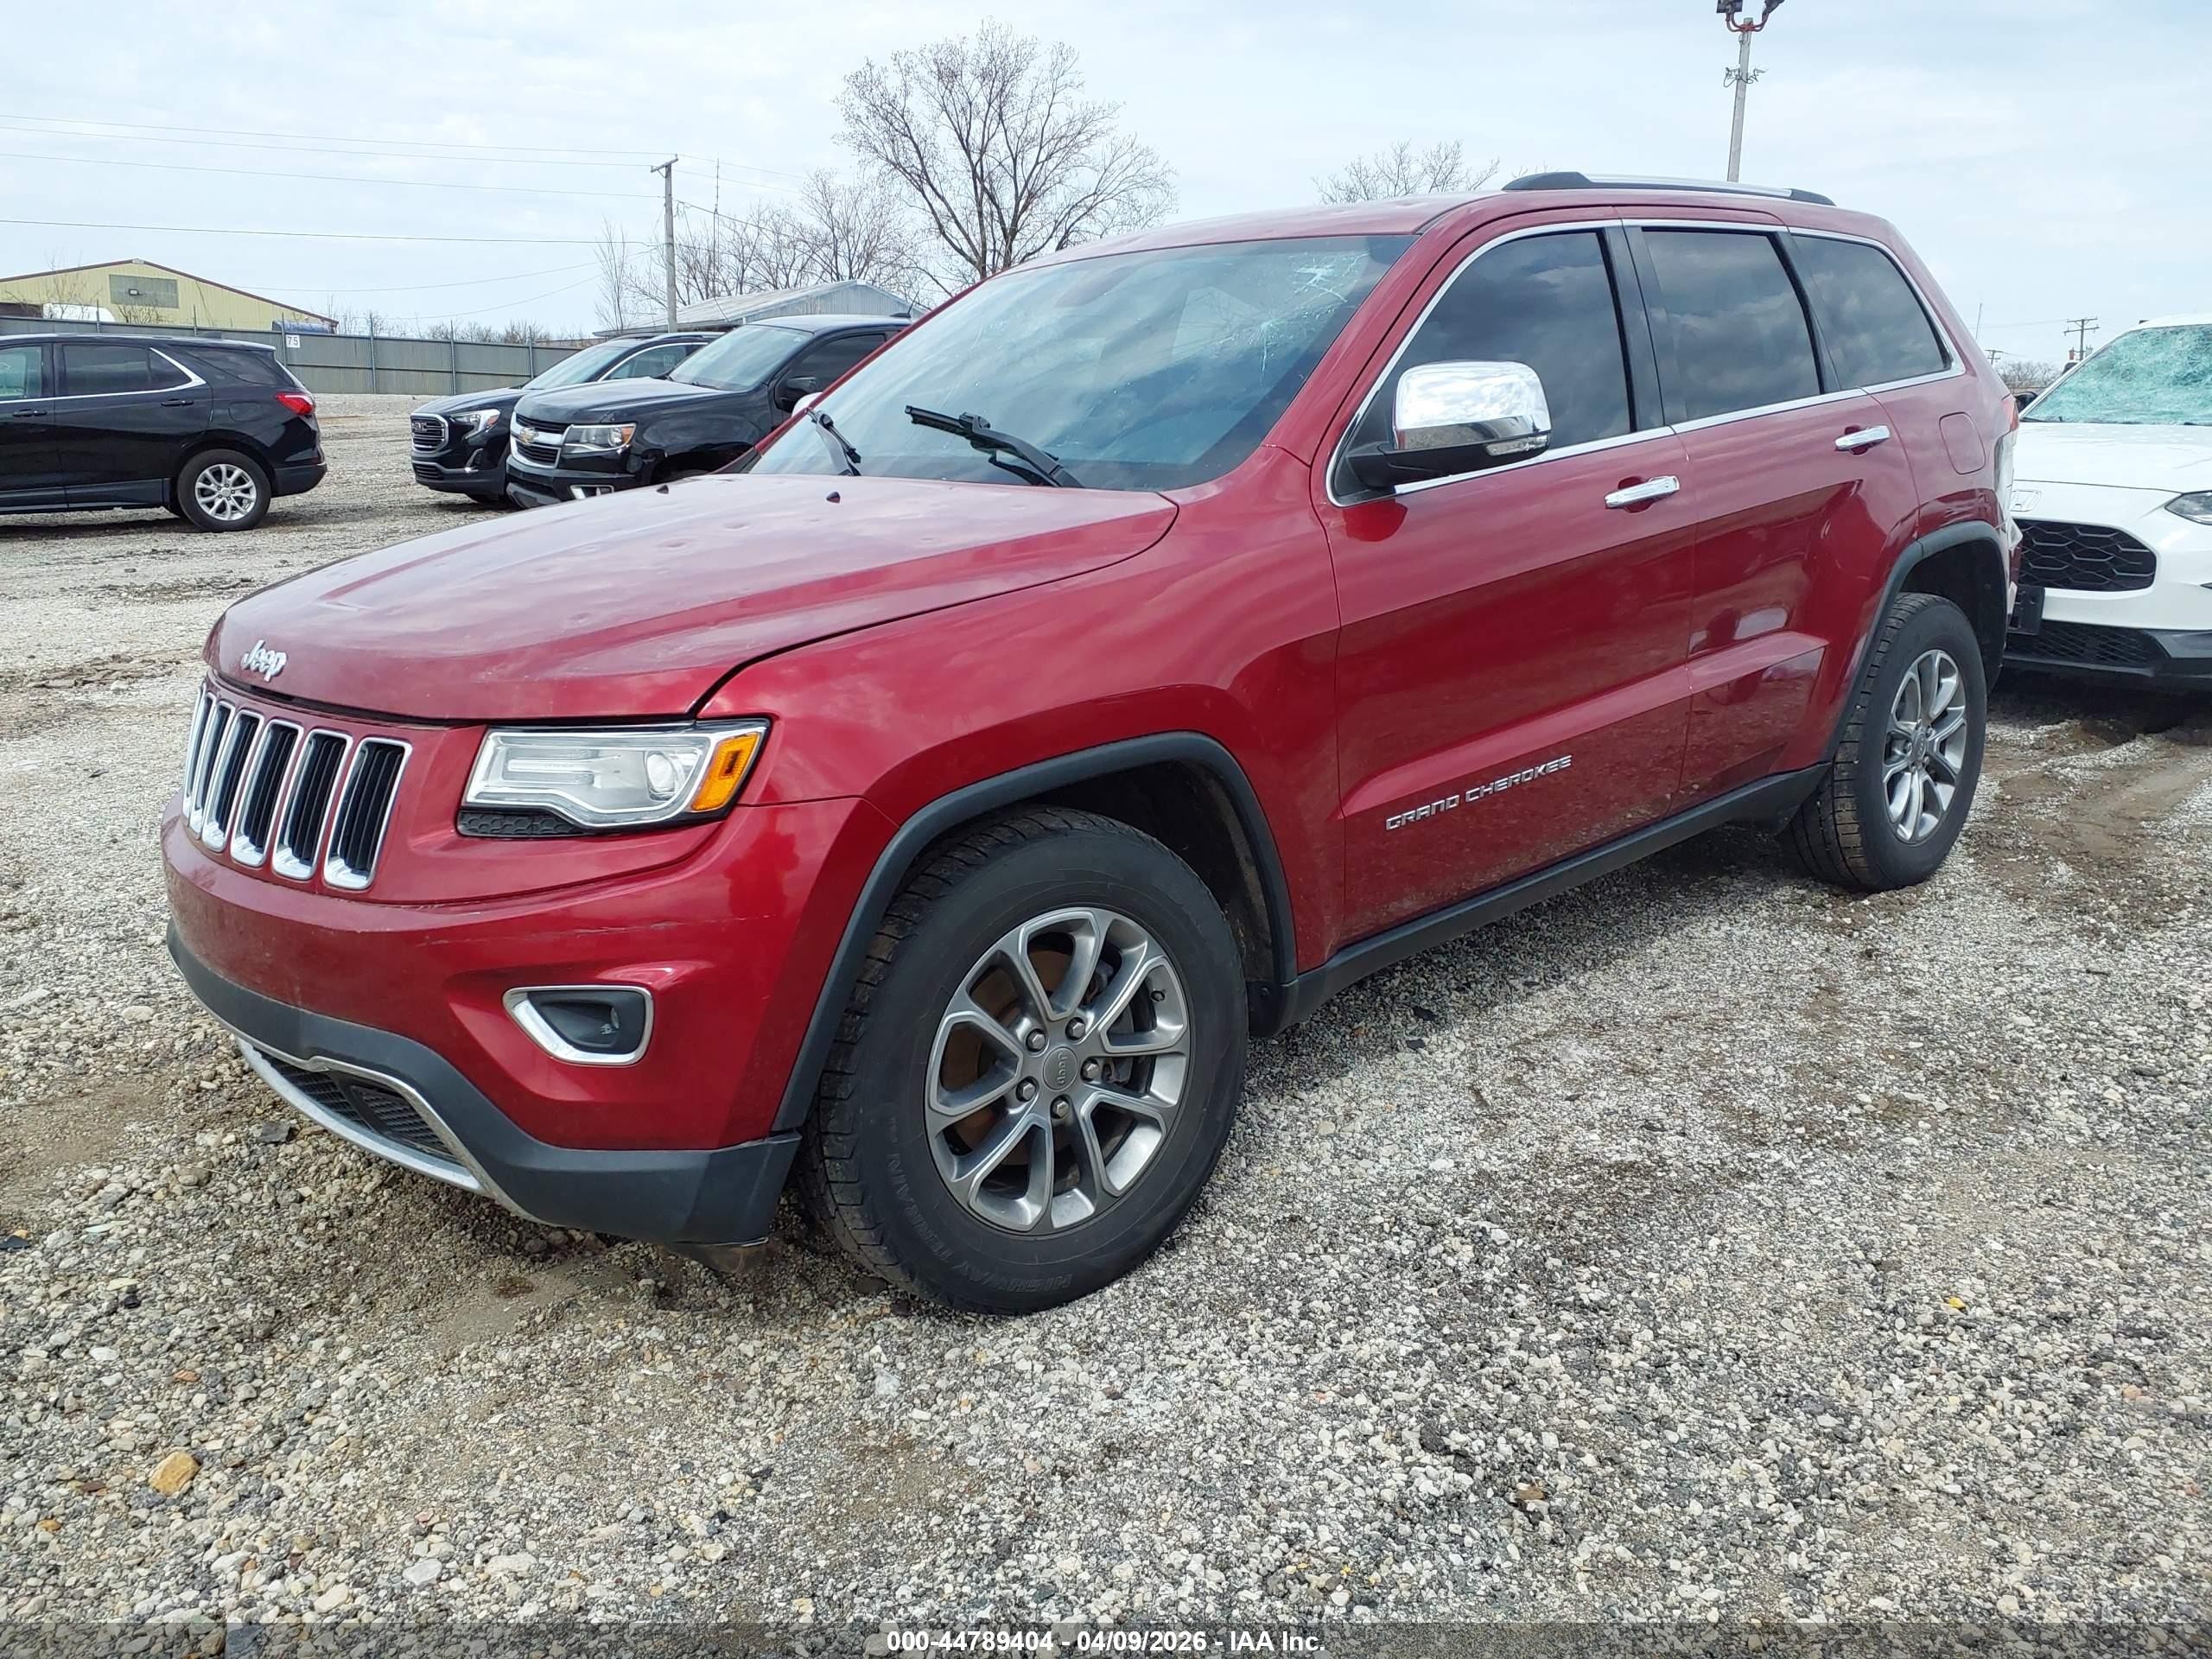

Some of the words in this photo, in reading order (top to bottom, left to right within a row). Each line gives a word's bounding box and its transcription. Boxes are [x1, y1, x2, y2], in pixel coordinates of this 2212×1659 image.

[287, 336, 299, 346] 75
[240, 639, 288, 683] Jeep
[1385, 793, 1460, 830] GRAND
[1465, 754, 1572, 803] CHEROKEE
[1057, 1052, 1069, 1085] Jeep
